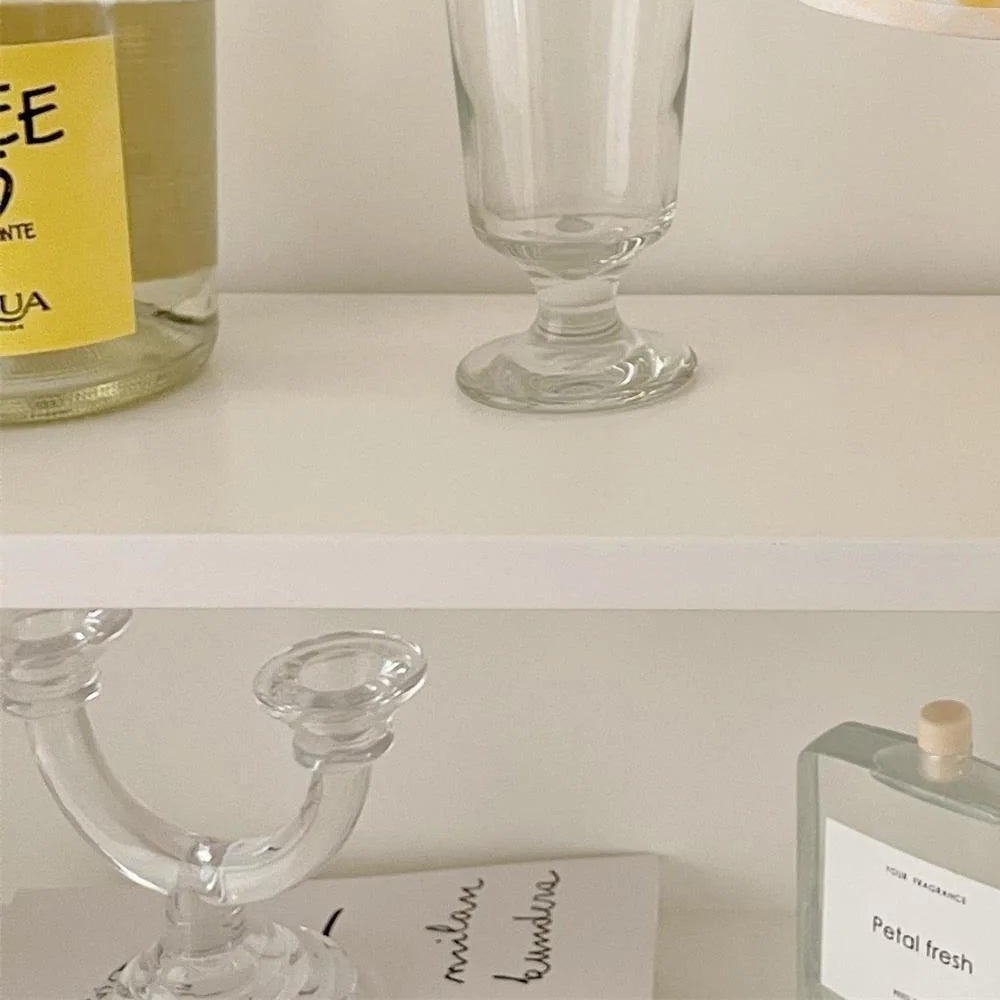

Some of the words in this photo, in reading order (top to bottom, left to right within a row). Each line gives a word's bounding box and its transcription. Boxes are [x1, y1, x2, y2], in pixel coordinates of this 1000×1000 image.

[885, 865, 908, 881] YOUR
[912, 876, 967, 905] FRAGRANCE
[425, 878, 485, 984] milan
[872, 915, 920, 953] Petal
[926, 939, 973, 975] fresh
